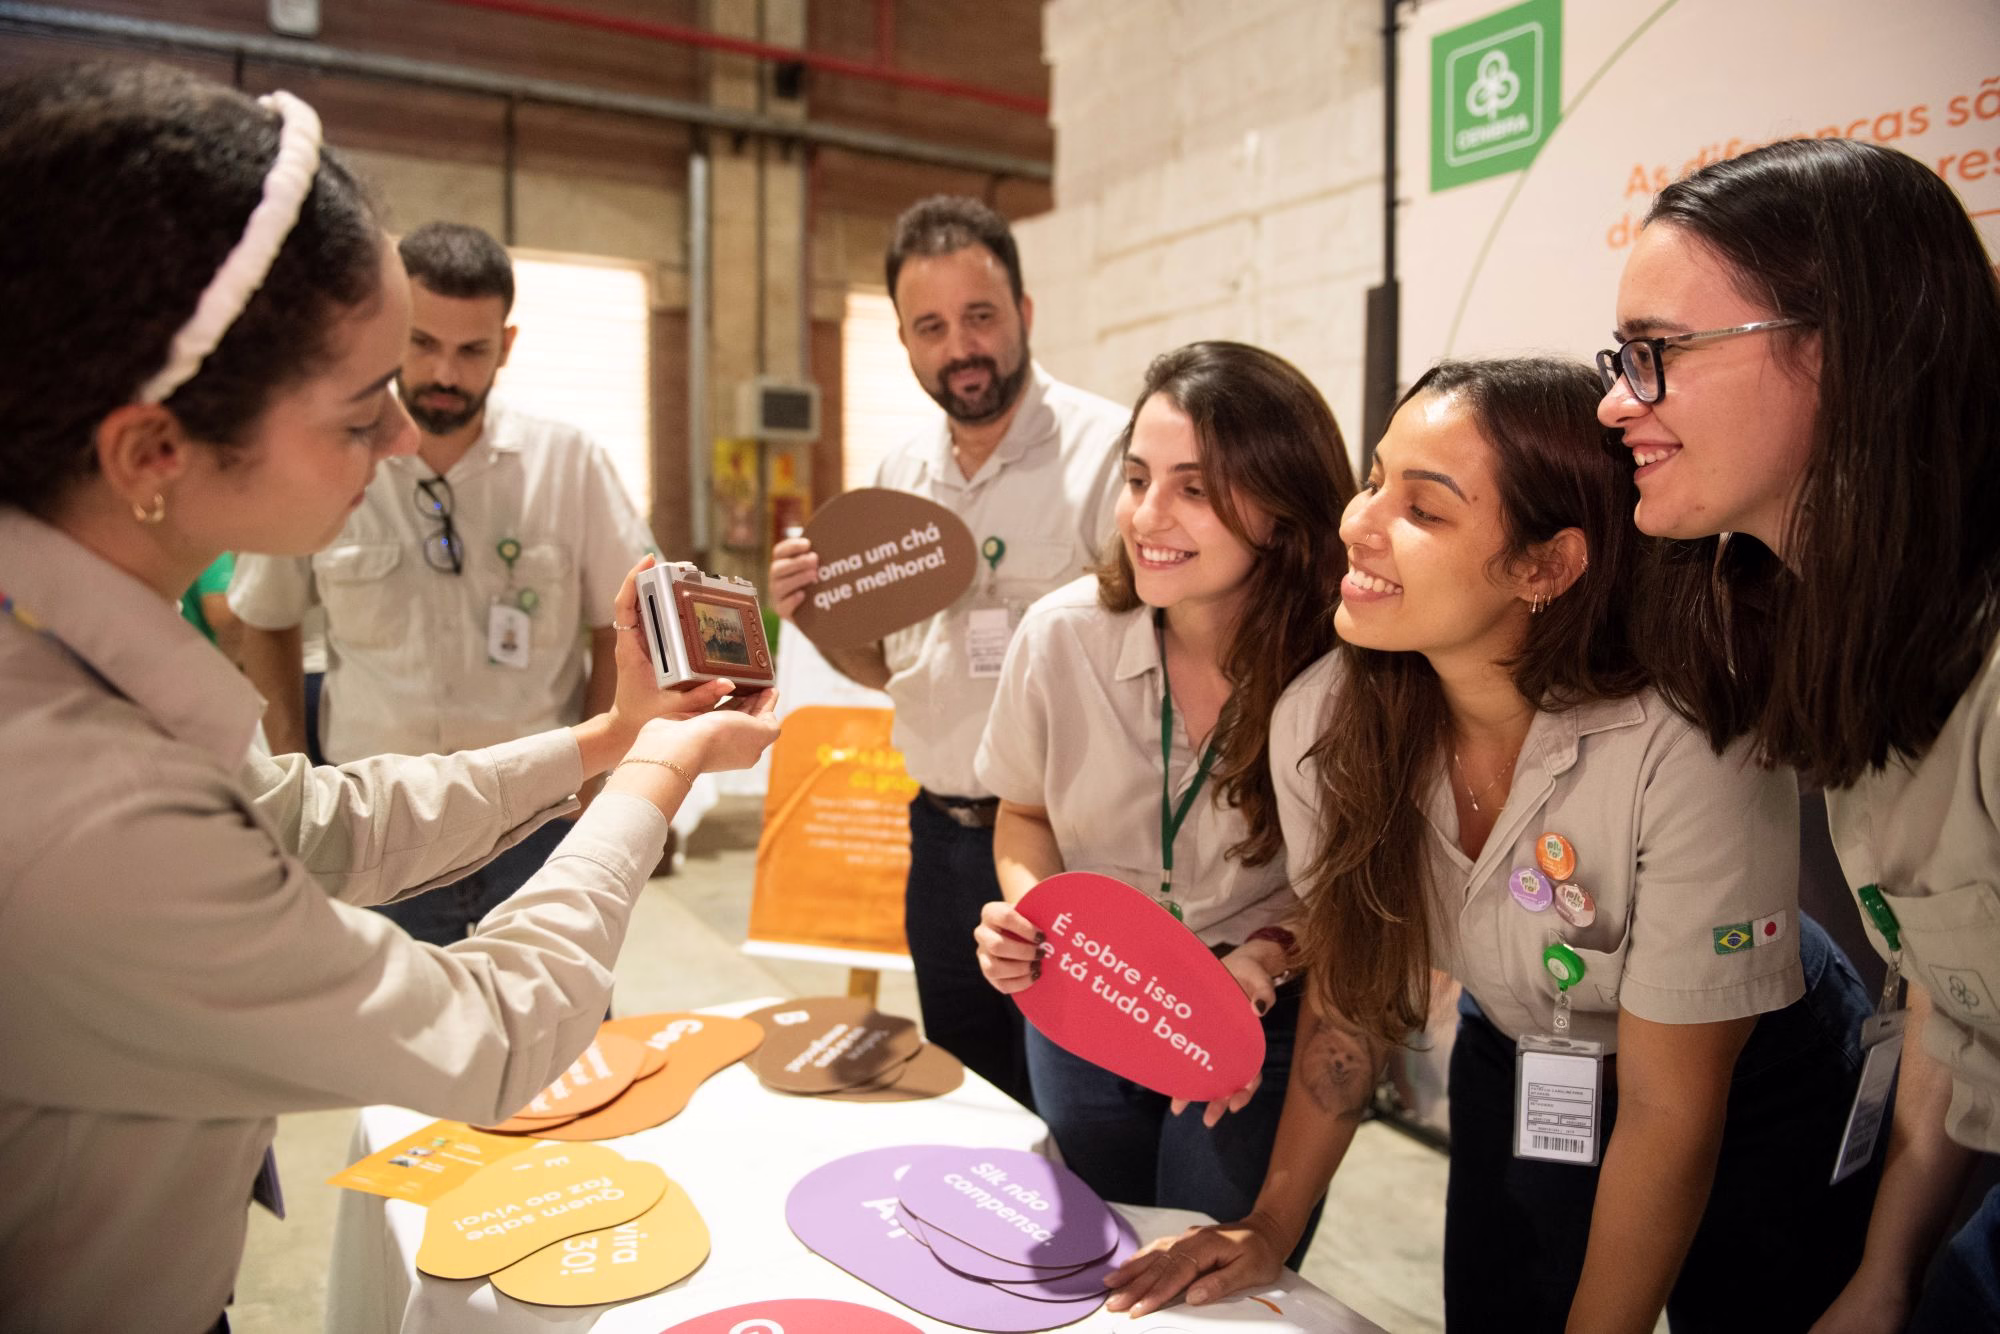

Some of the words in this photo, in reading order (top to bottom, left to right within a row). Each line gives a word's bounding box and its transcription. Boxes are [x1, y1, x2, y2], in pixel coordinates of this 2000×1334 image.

[1624, 163, 1670, 198] As
[818, 553, 863, 581] oma
[865, 541, 899, 564] um
[901, 522, 941, 550] chá
[814, 583, 853, 611] que
[856, 546, 946, 594] melhora!
[1051, 912, 1073, 937] É
[1071, 931, 1142, 986] sobre
[1143, 976, 1193, 1020] isso
[1039, 941, 1055, 958] e
[1059, 952, 1089, 982] tá
[1091, 975, 1150, 1024] tudo
[1153, 1016, 1214, 1072] bem.
[525, 1190, 562, 1210] ao
[567, 1176, 614, 1196] faz
[1003, 1179, 1049, 1212] não
[452, 1204, 522, 1231] vivo!
[541, 1188, 625, 1224] Quem
[464, 1214, 536, 1242] sabe
[612, 1221, 648, 1265] vira
[560, 1236, 598, 1276] 30!
